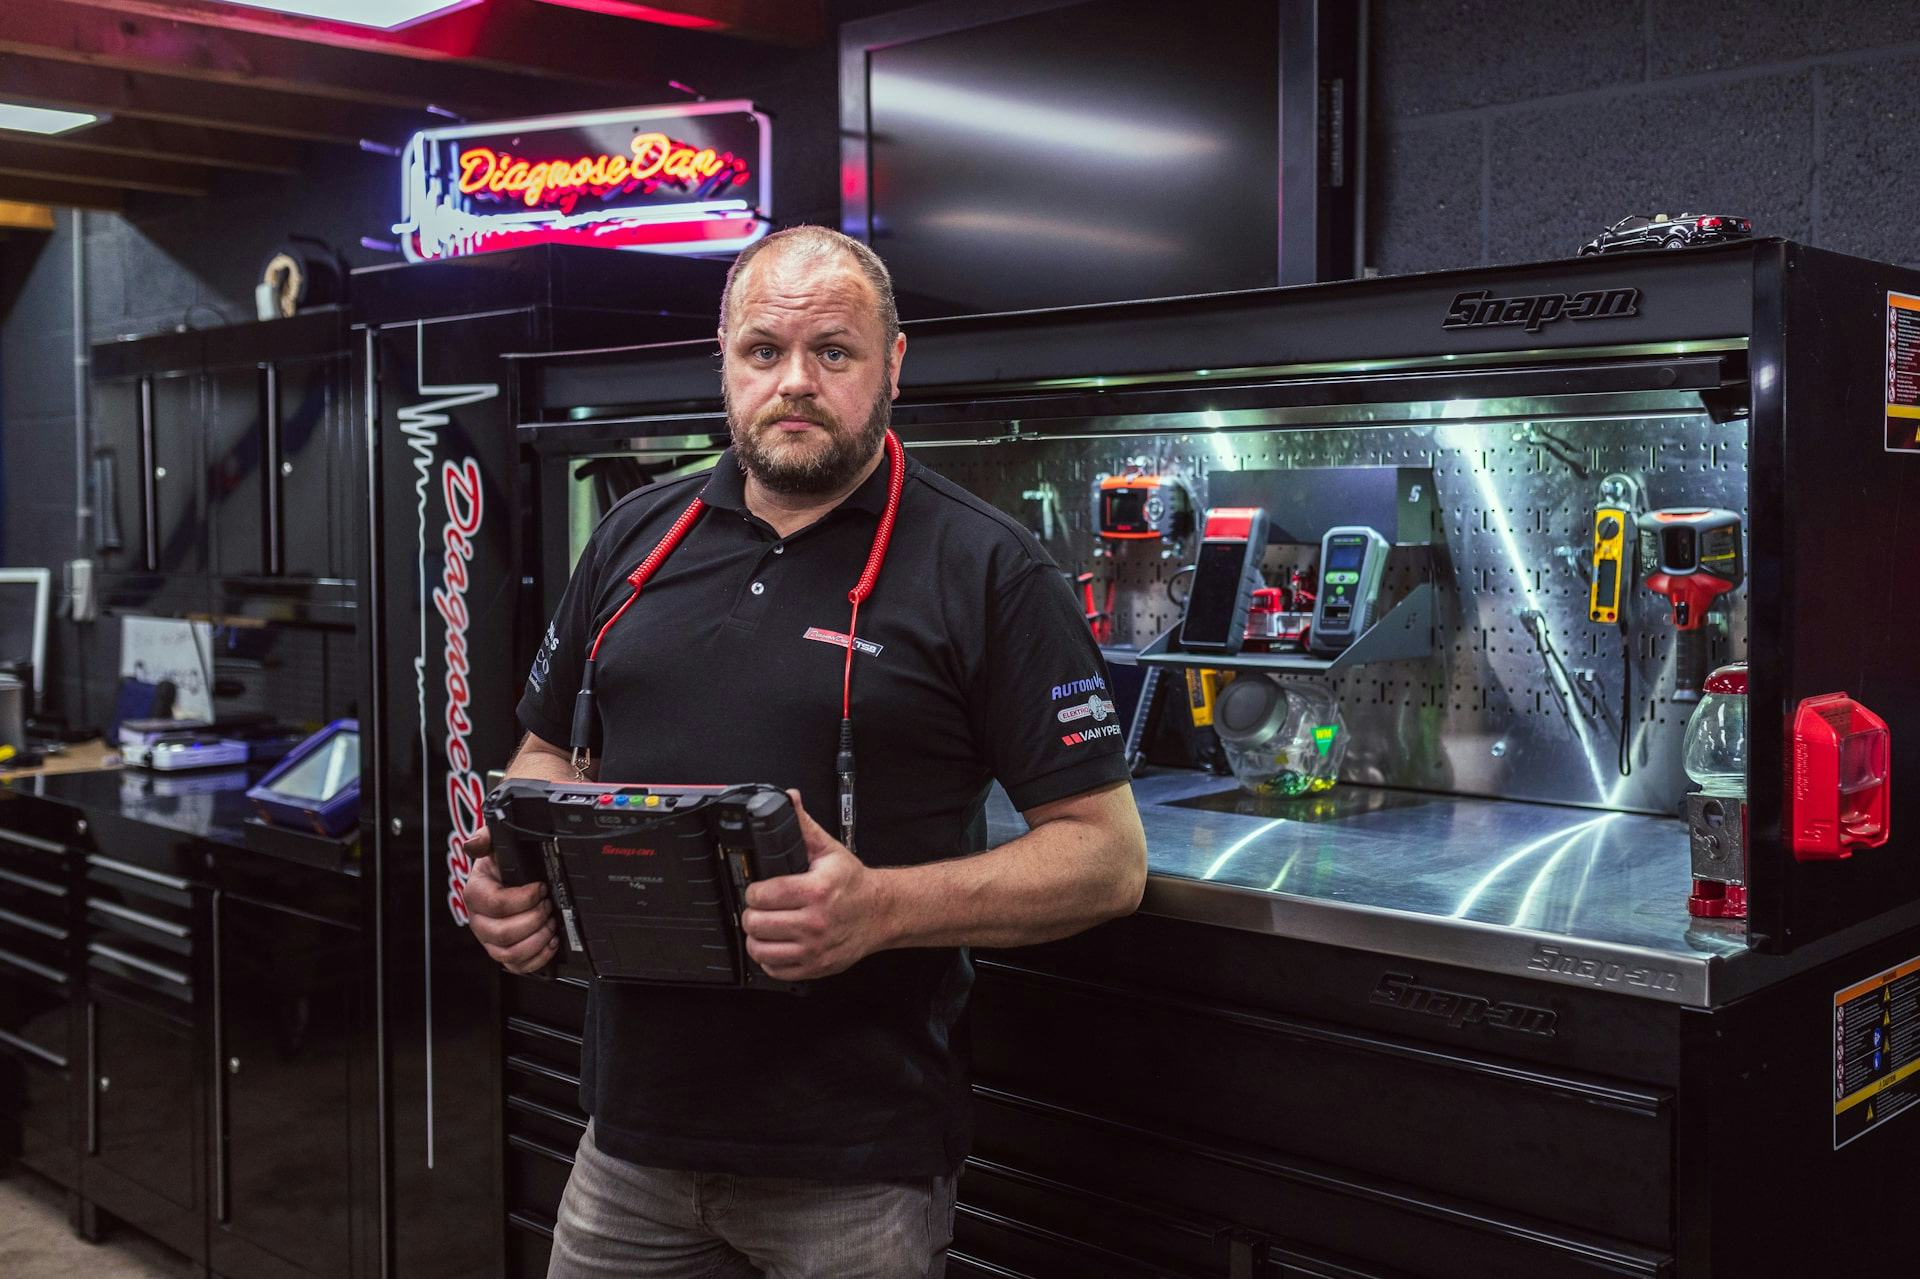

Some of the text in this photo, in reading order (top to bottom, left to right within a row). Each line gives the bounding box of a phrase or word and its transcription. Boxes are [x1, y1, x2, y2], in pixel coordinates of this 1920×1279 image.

[1442, 287, 1638, 332] Snap-on
[856, 640, 877, 653] TSB
[1527, 944, 1681, 992] Snap-on
[1369, 970, 1559, 1038] Snap-on
